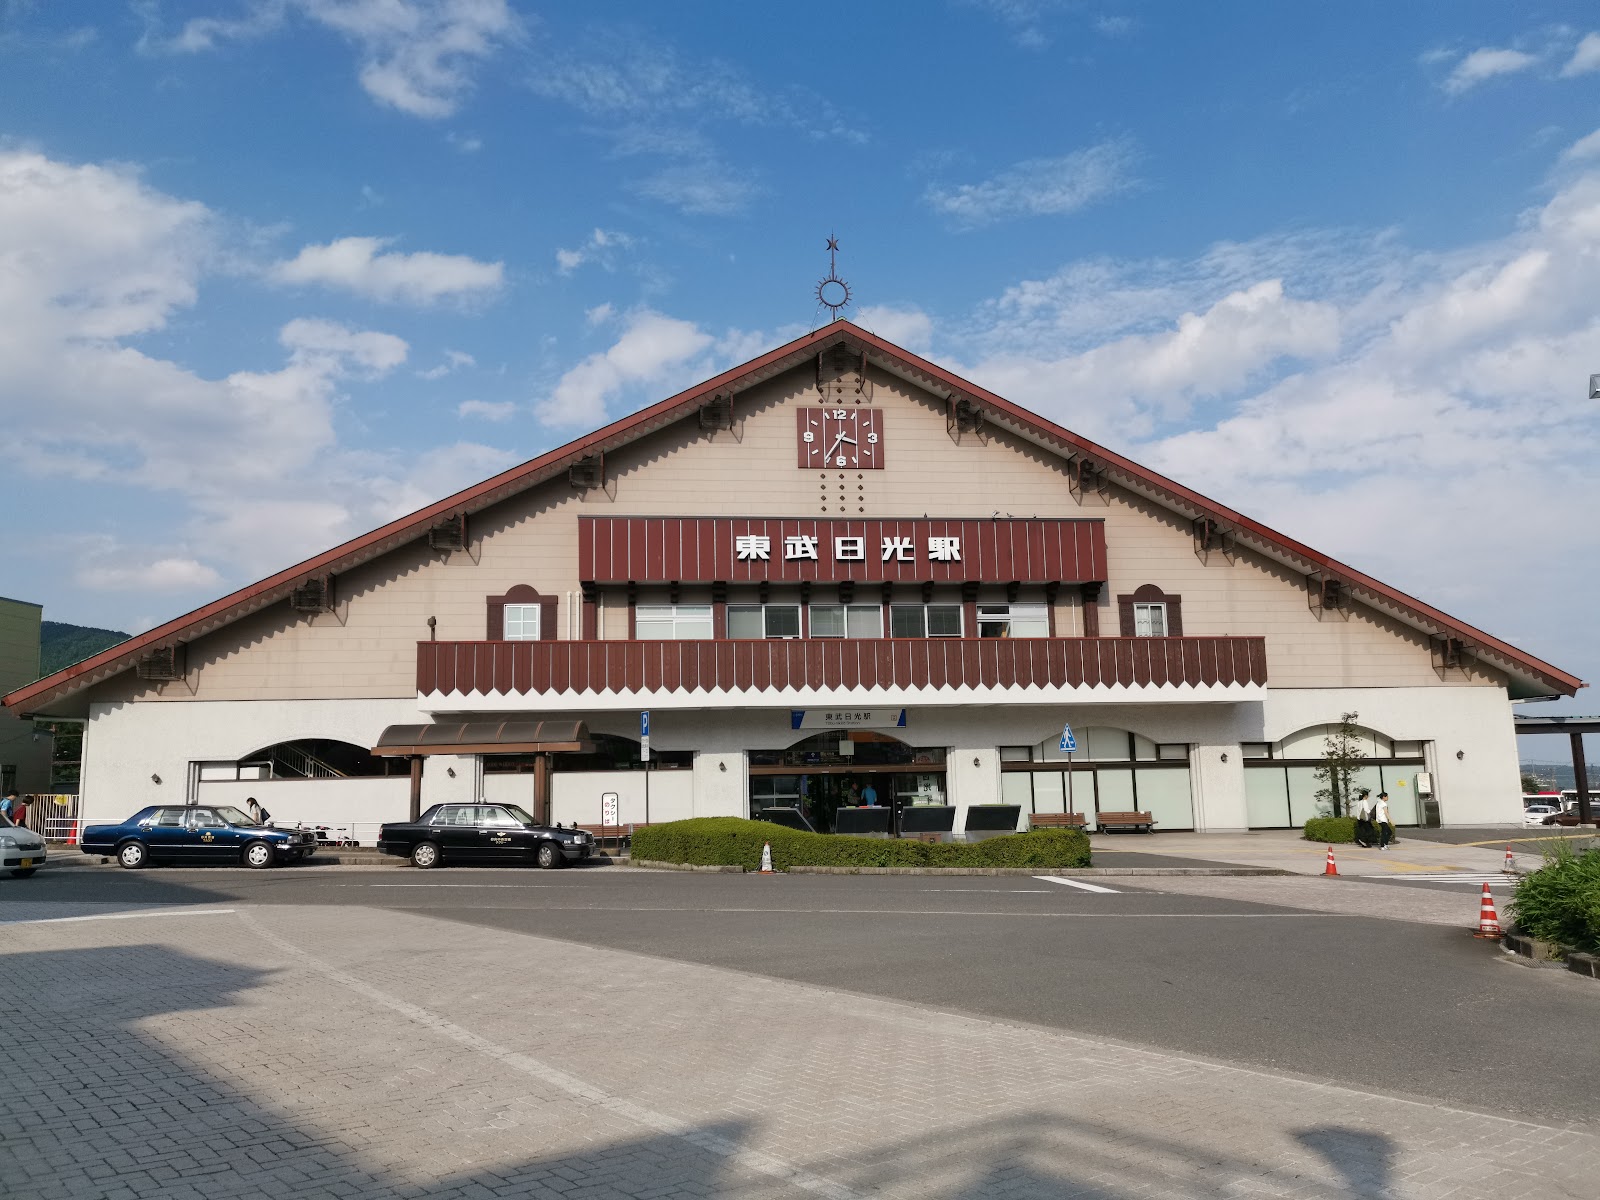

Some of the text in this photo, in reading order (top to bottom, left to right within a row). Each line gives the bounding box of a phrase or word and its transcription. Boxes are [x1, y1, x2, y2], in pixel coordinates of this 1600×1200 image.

[832, 409, 847, 420] 12
[803, 431, 814, 443] 9
[867, 432, 878, 444] 3
[836, 455, 847, 467] 6
[736, 535, 962, 561] 東武日光駅
[825, 712, 871, 721] 東武日光駅
[642, 714, 648, 734] P
